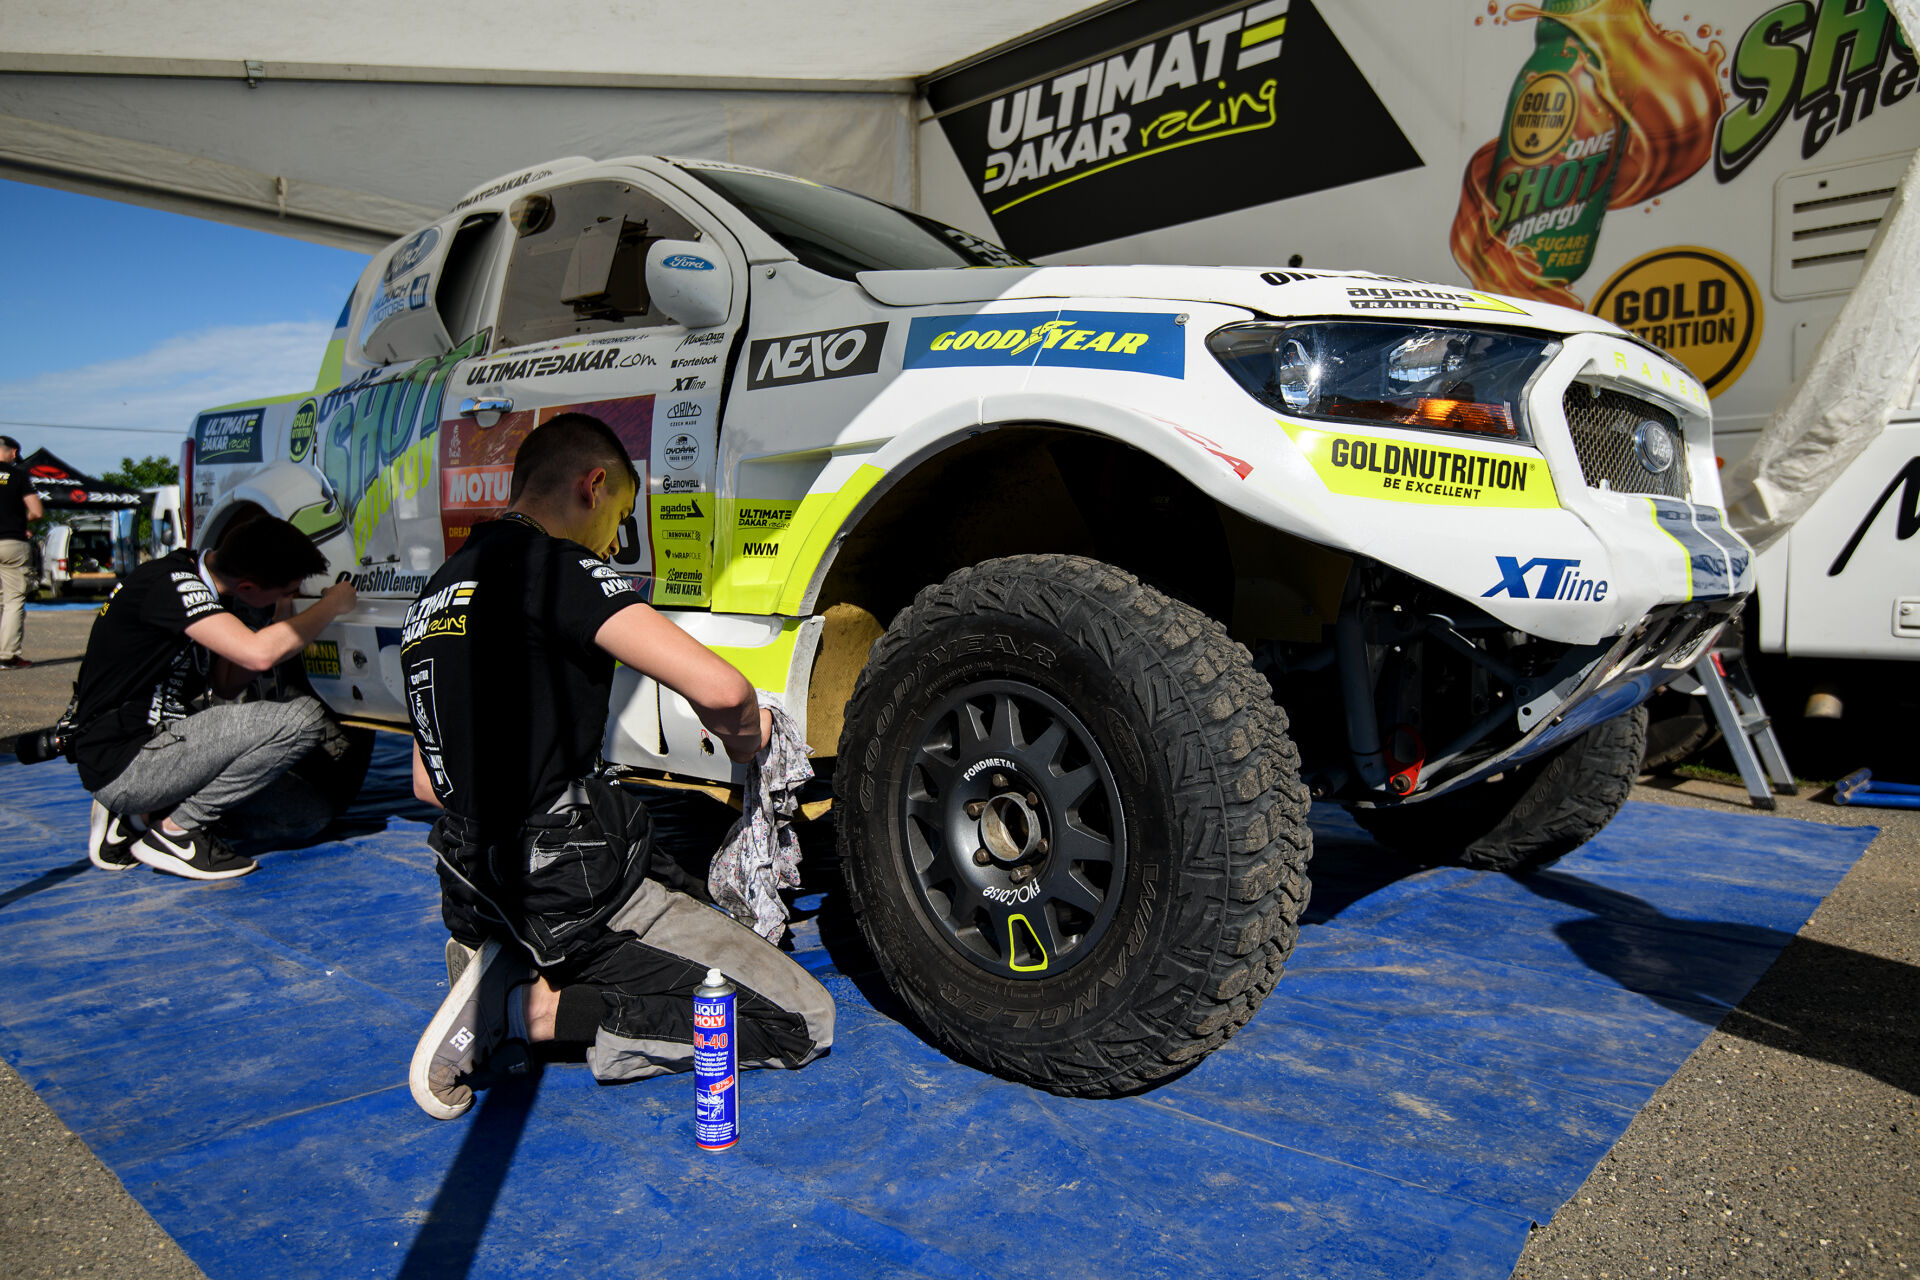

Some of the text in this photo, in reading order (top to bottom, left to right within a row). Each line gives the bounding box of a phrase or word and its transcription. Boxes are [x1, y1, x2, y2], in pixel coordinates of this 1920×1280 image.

[986, 0, 1290, 151] ULTIMATE
[1522, 91, 1566, 114] GOLD
[1516, 113, 1566, 129] NUTRITION
[983, 78, 1278, 195] DAKAR racing
[1565, 128, 1617, 161] ONE
[1489, 151, 1609, 237] SHOT
[1505, 201, 1588, 250] energy
[1532, 233, 1590, 252] SUGARS
[669, 255, 705, 270] Ford
[1545, 250, 1585, 268] FREE
[1346, 287, 1476, 303] agados
[1613, 278, 1727, 323] GOLD
[1353, 301, 1457, 311] TRAILERS
[677, 354, 719, 369] Fortelock
[755, 328, 868, 382] NEXO
[670, 375, 707, 393] XTline
[204, 413, 260, 436] ULTIMATE
[293, 410, 314, 428] GOLD
[201, 435, 229, 452] DAKAR
[1331, 437, 1528, 492] GOLDNUTRITION
[1383, 477, 1482, 500] BE EXCELLENT
[660, 504, 692, 514] agados
[739, 508, 793, 520] ULTIMATE
[738, 519, 768, 527] DAKAR
[742, 542, 779, 556] NWM
[675, 569, 703, 581] premio
[1480, 554, 1609, 603] XTline
[665, 582, 702, 597] PNEU KAFKA
[305, 660, 340, 676] FILTER
[963, 758, 1019, 782] FONDMETAL
[694, 1003, 723, 1016] LIQUI
[694, 1015, 725, 1027] MOLY
